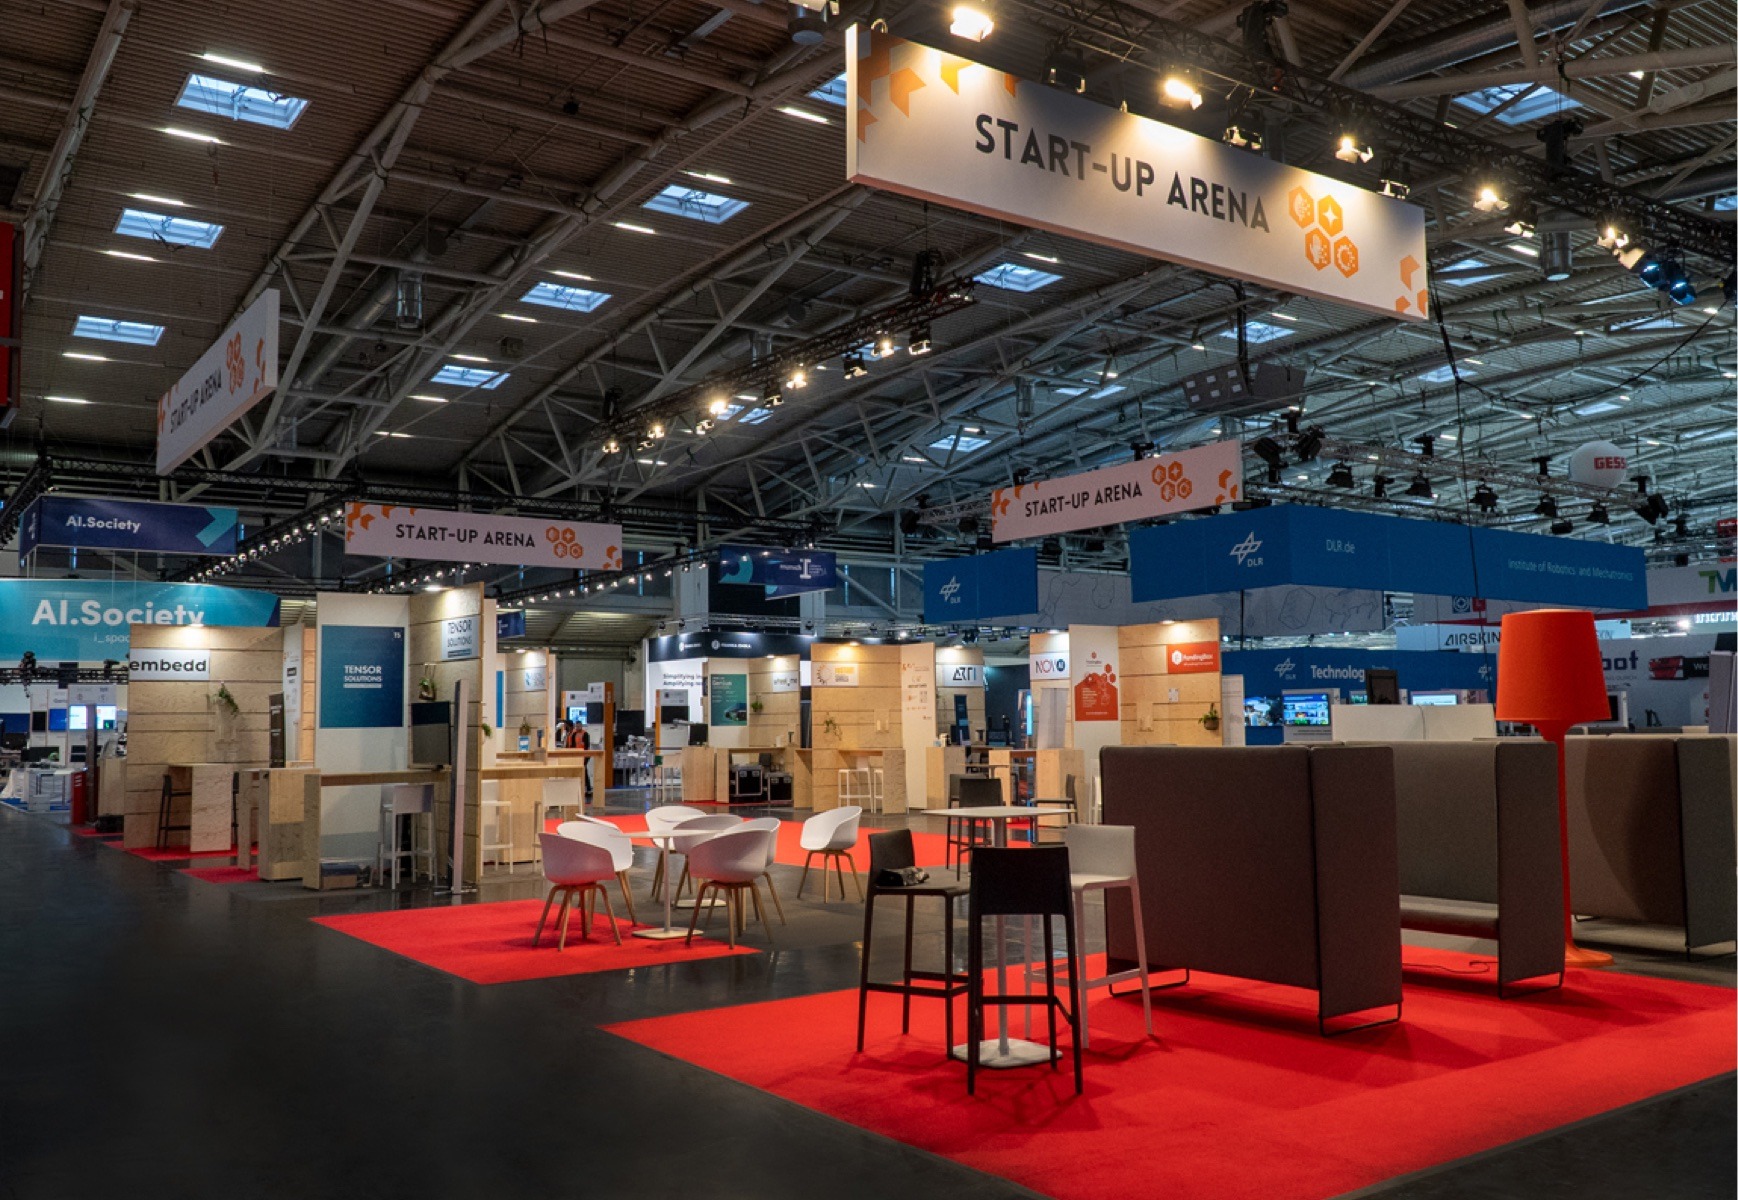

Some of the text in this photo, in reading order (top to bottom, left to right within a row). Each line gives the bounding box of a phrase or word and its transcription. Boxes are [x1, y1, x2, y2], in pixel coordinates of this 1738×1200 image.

[975, 113, 1270, 233] START-UP ARENA
[200, 366, 222, 407] ARENA
[1025, 481, 1142, 517] START-UP ARENA
[66, 515, 141, 533] AI.Society
[396, 524, 535, 548] START-UP ARENA
[1326, 539, 1355, 553] DLR.de
[1247, 557, 1263, 567] DLR
[1508, 559, 1633, 581] Institute of Robotics and Mechatronics
[31, 600, 204, 626] AI.Society
[447, 619, 472, 634] TENSOR
[344, 665, 382, 674] TENSOR
